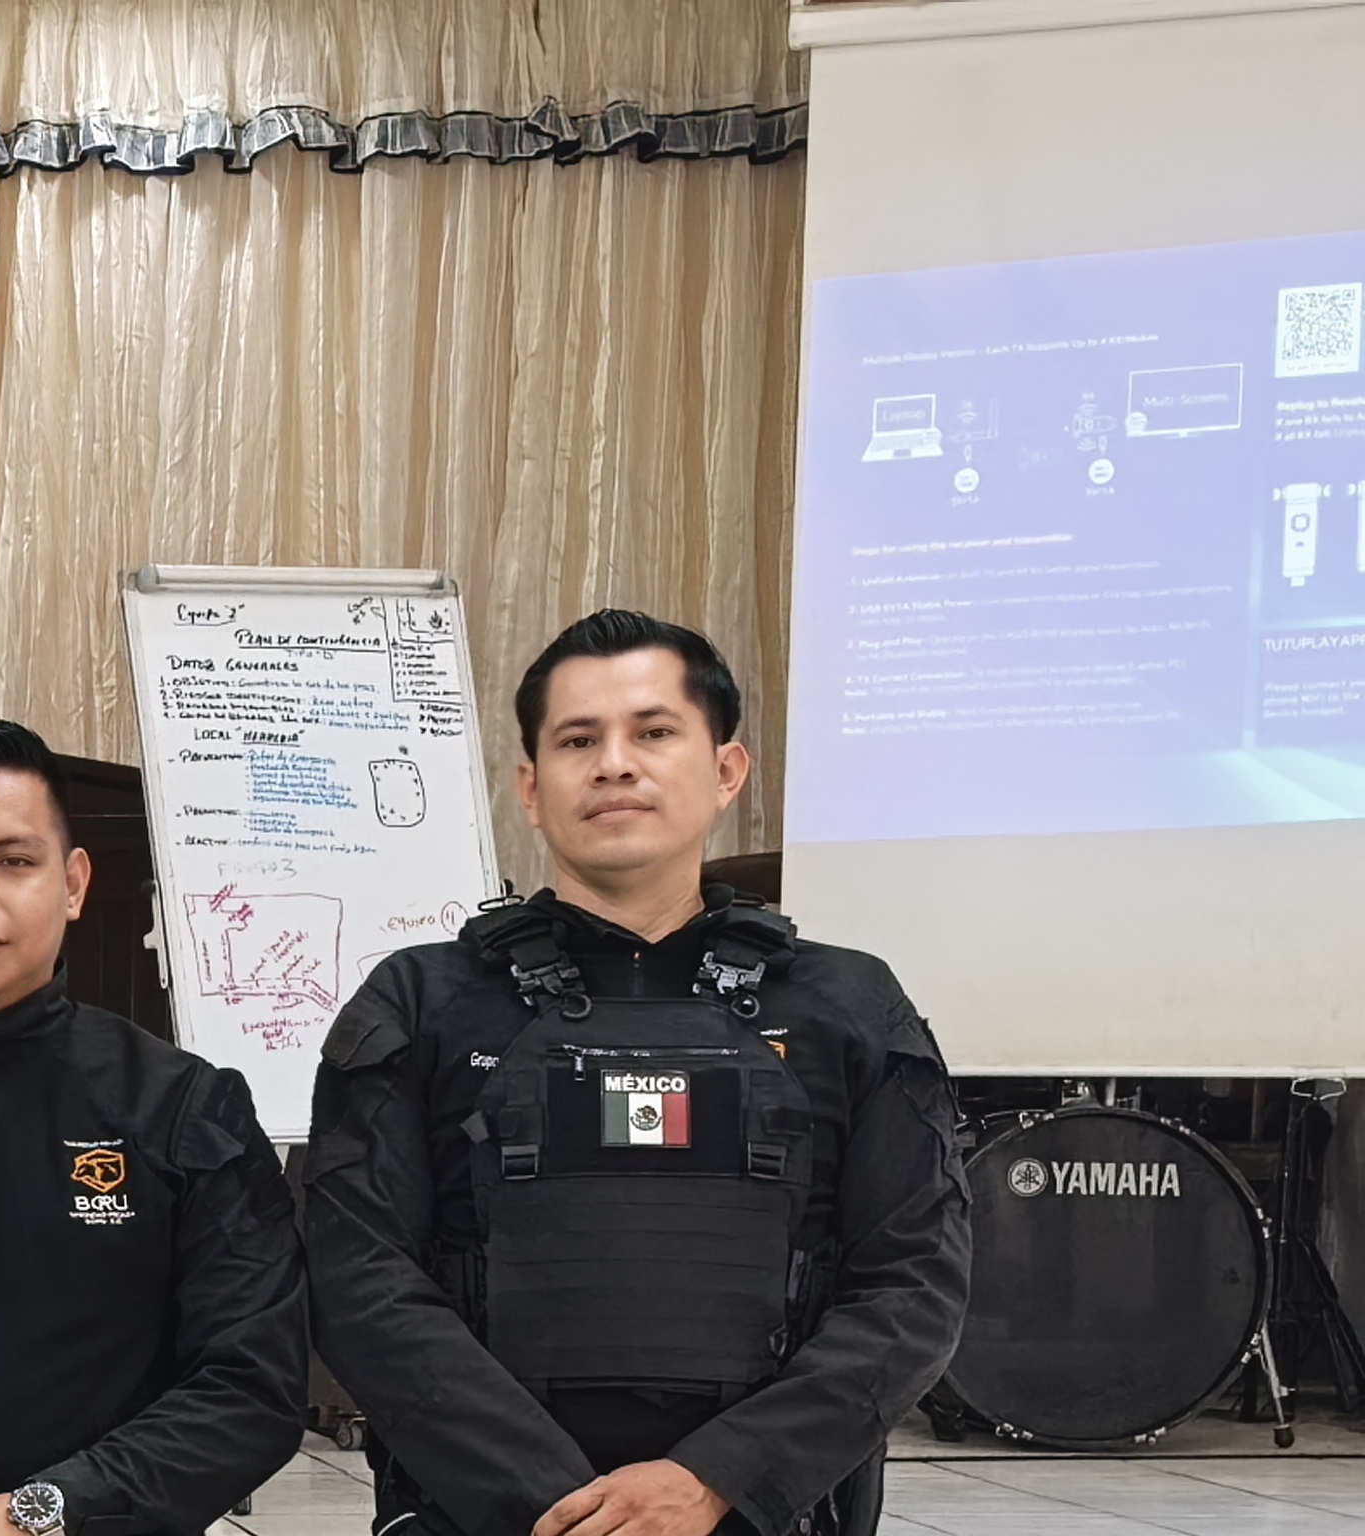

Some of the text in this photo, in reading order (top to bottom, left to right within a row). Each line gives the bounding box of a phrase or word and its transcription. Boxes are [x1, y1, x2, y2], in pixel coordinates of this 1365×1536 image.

[882, 408, 926, 422] Laptop
[166, 655, 299, 672] DATOS GENERALES
[194, 728, 232, 741] LOCAL
[604, 1072, 686, 1092] MÉXICO
[1051, 1161, 1180, 1197] YAMAHA
